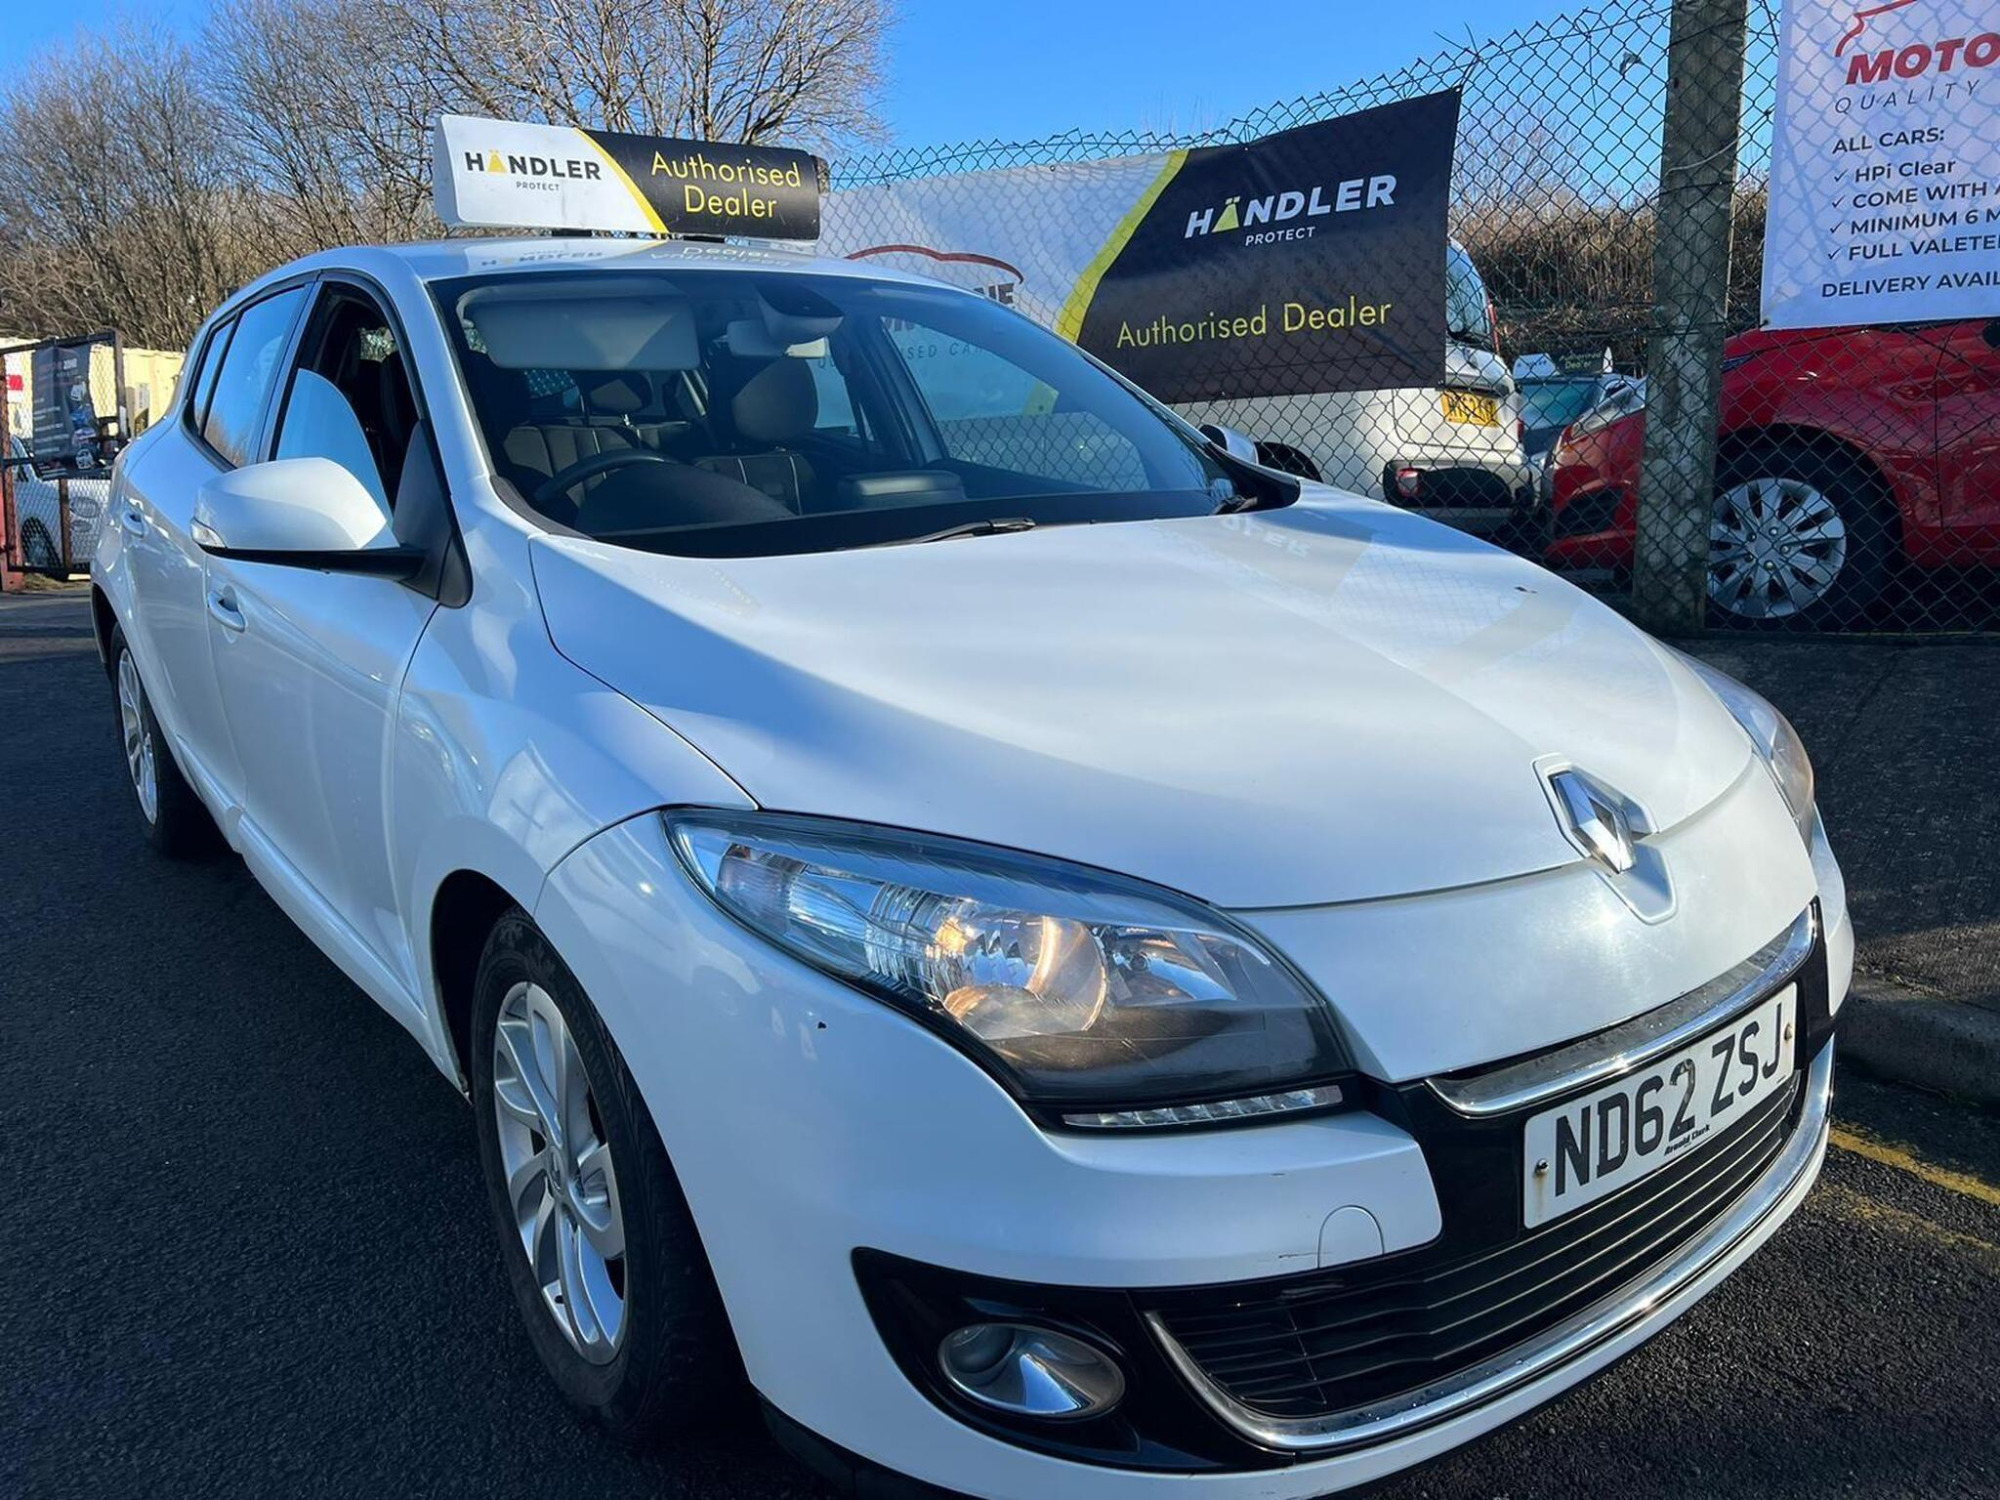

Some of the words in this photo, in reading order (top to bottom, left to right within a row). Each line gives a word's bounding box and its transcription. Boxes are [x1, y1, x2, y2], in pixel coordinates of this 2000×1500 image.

[1846, 32, 2000, 85] MOTO
[1835, 80, 1979, 116] QUALITY
[1832, 136, 1872, 154] ALL
[1879, 127, 1945, 147] CARS:
[465, 149, 600, 180] HÄNDLER
[651, 151, 800, 187] Authorised
[1855, 163, 1892, 183] HPi
[1899, 160, 1956, 177] Clear
[516, 181, 560, 192] PROTECT
[1853, 187, 1918, 209] COME
[1926, 182, 1987, 201] WITH
[685, 184, 777, 218] Dealer
[1184, 174, 1397, 239] HÄNDLER
[1851, 211, 1957, 235] MINIMUM
[1965, 209, 1979, 224] 6
[1245, 226, 1316, 247] PROTECT
[1849, 243, 1903, 261] FULL
[1910, 234, 2000, 255] VALETE
[1822, 275, 1931, 298] DELIVERY
[1936, 271, 2000, 289] AVAIL
[1116, 304, 1266, 349] Authorised
[1284, 295, 1392, 332] Dealer
[901, 344, 937, 360] SED
[1555, 1058, 1695, 1197] ND62
[1710, 1002, 1782, 1118] ZSJ
